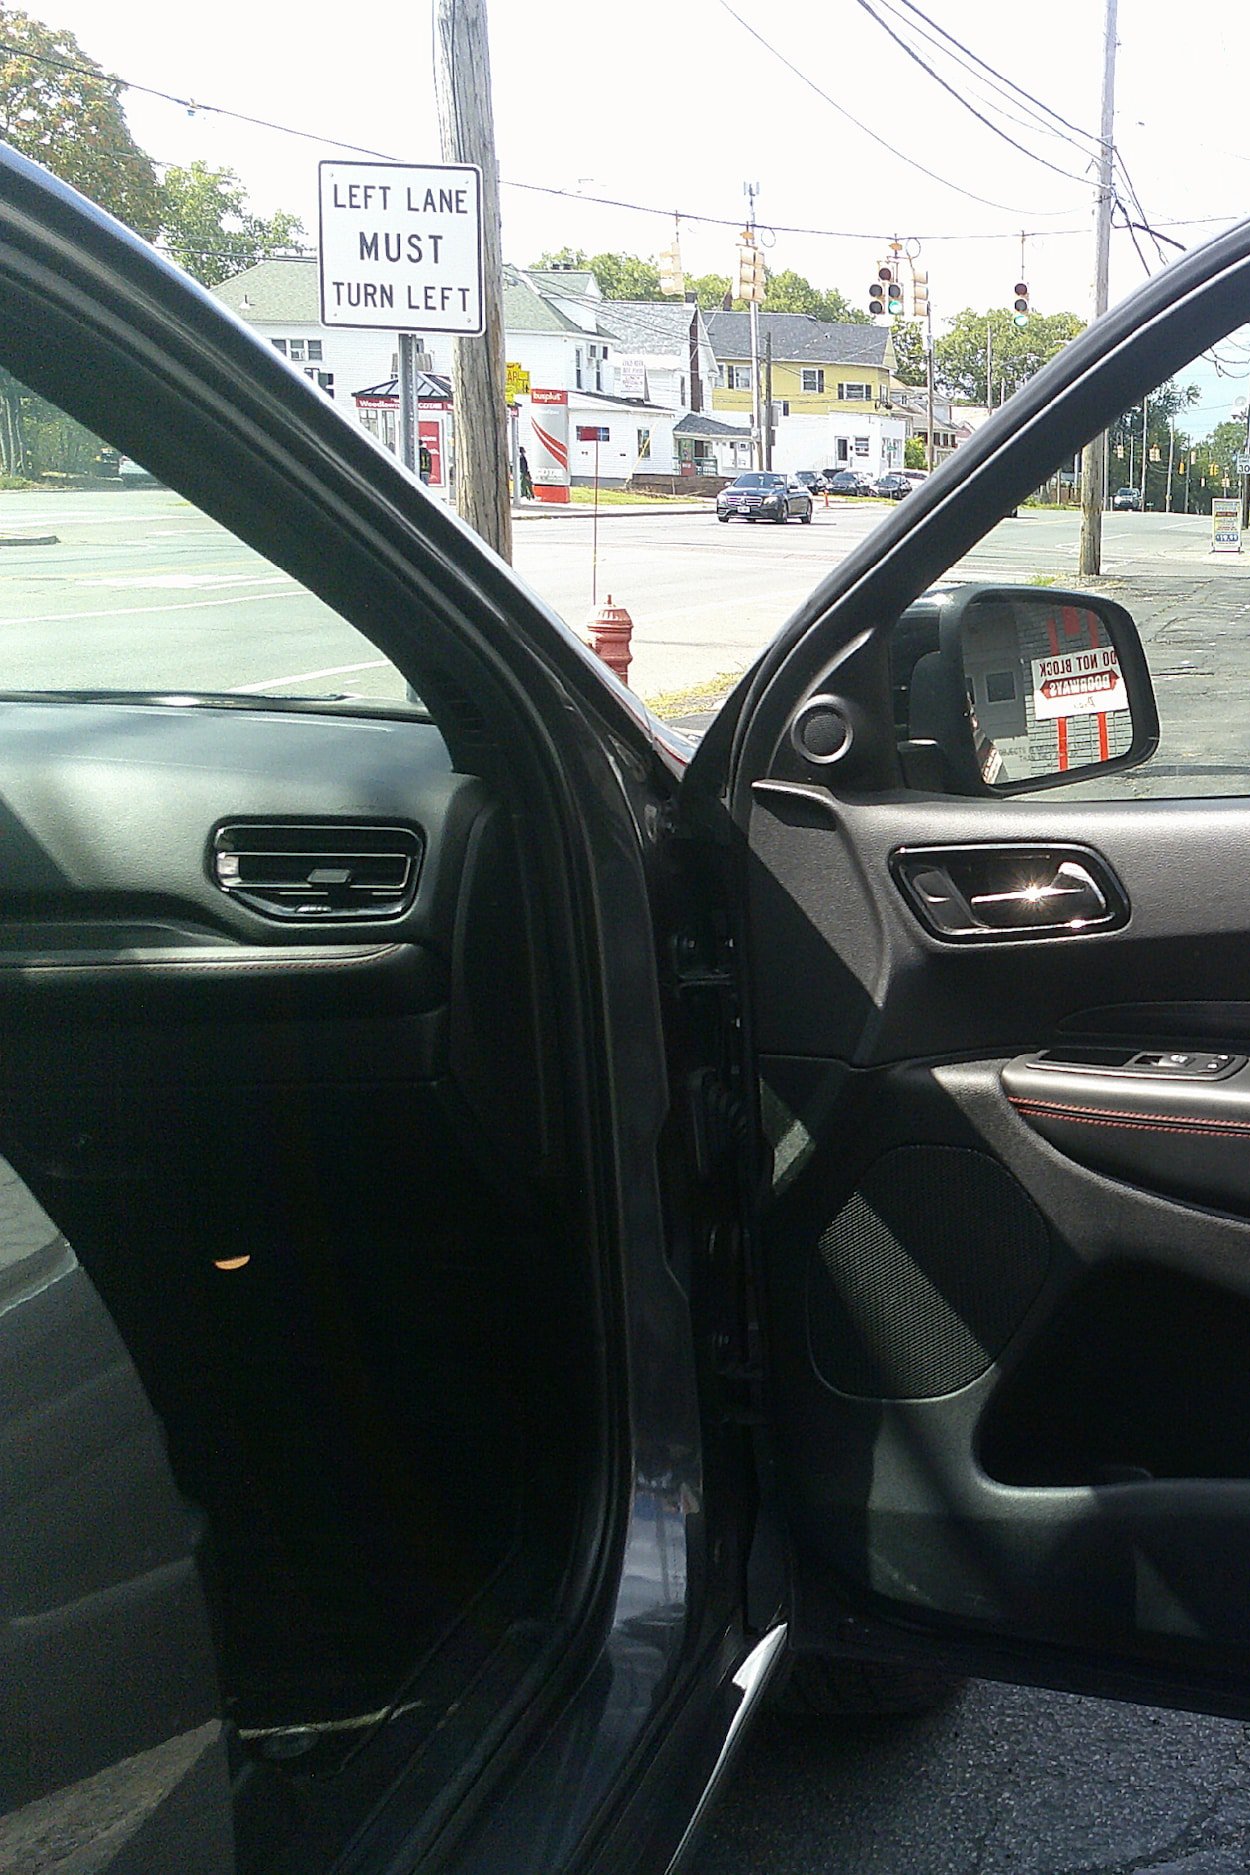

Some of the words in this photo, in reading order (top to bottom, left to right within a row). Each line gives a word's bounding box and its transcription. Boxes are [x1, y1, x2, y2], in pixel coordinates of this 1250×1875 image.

[334, 184, 391, 210] LEFT
[407, 187, 468, 214] LANE
[359, 232, 443, 264] MUST
[332, 281, 393, 308] TURN
[407, 285, 470, 312] LEFT
[1238, 465, 1250, 473] 30
